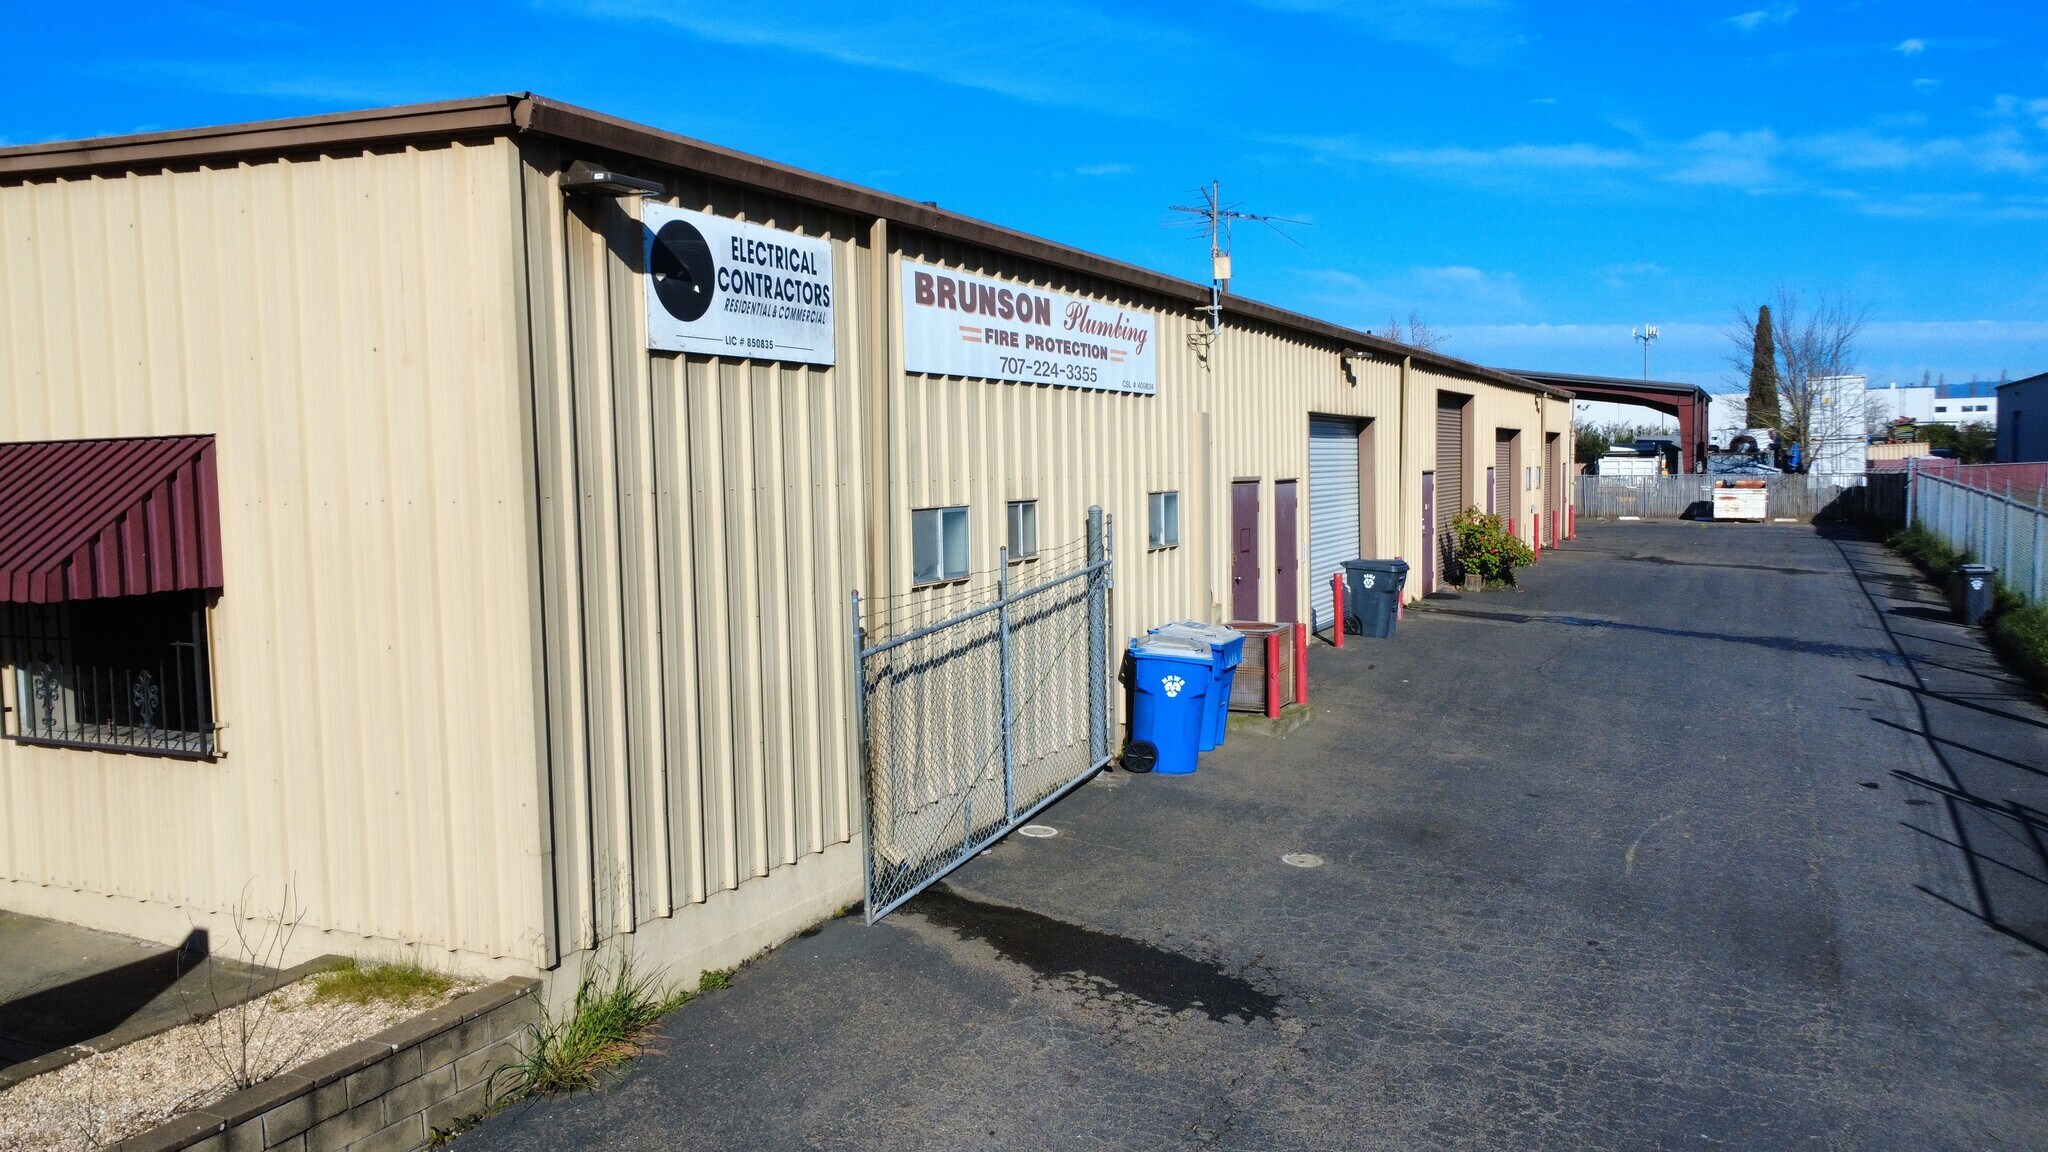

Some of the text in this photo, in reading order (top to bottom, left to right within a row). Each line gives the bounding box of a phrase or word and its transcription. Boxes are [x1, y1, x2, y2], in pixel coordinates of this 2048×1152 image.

[731, 235, 817, 276] ELECTRICAL
[717, 266, 830, 308] CONTRACTORS
[724, 297, 827, 325] RESIDENTIAL & COMMERCIAL
[914, 270, 1148, 356] BRUNSON Plumbing
[725, 335, 774, 350] LIC # 850835
[984, 327, 1109, 361] FIRE PROTECTION
[999, 356, 1098, 383] 707-224-3355
[1121, 380, 1132, 389] CSL
